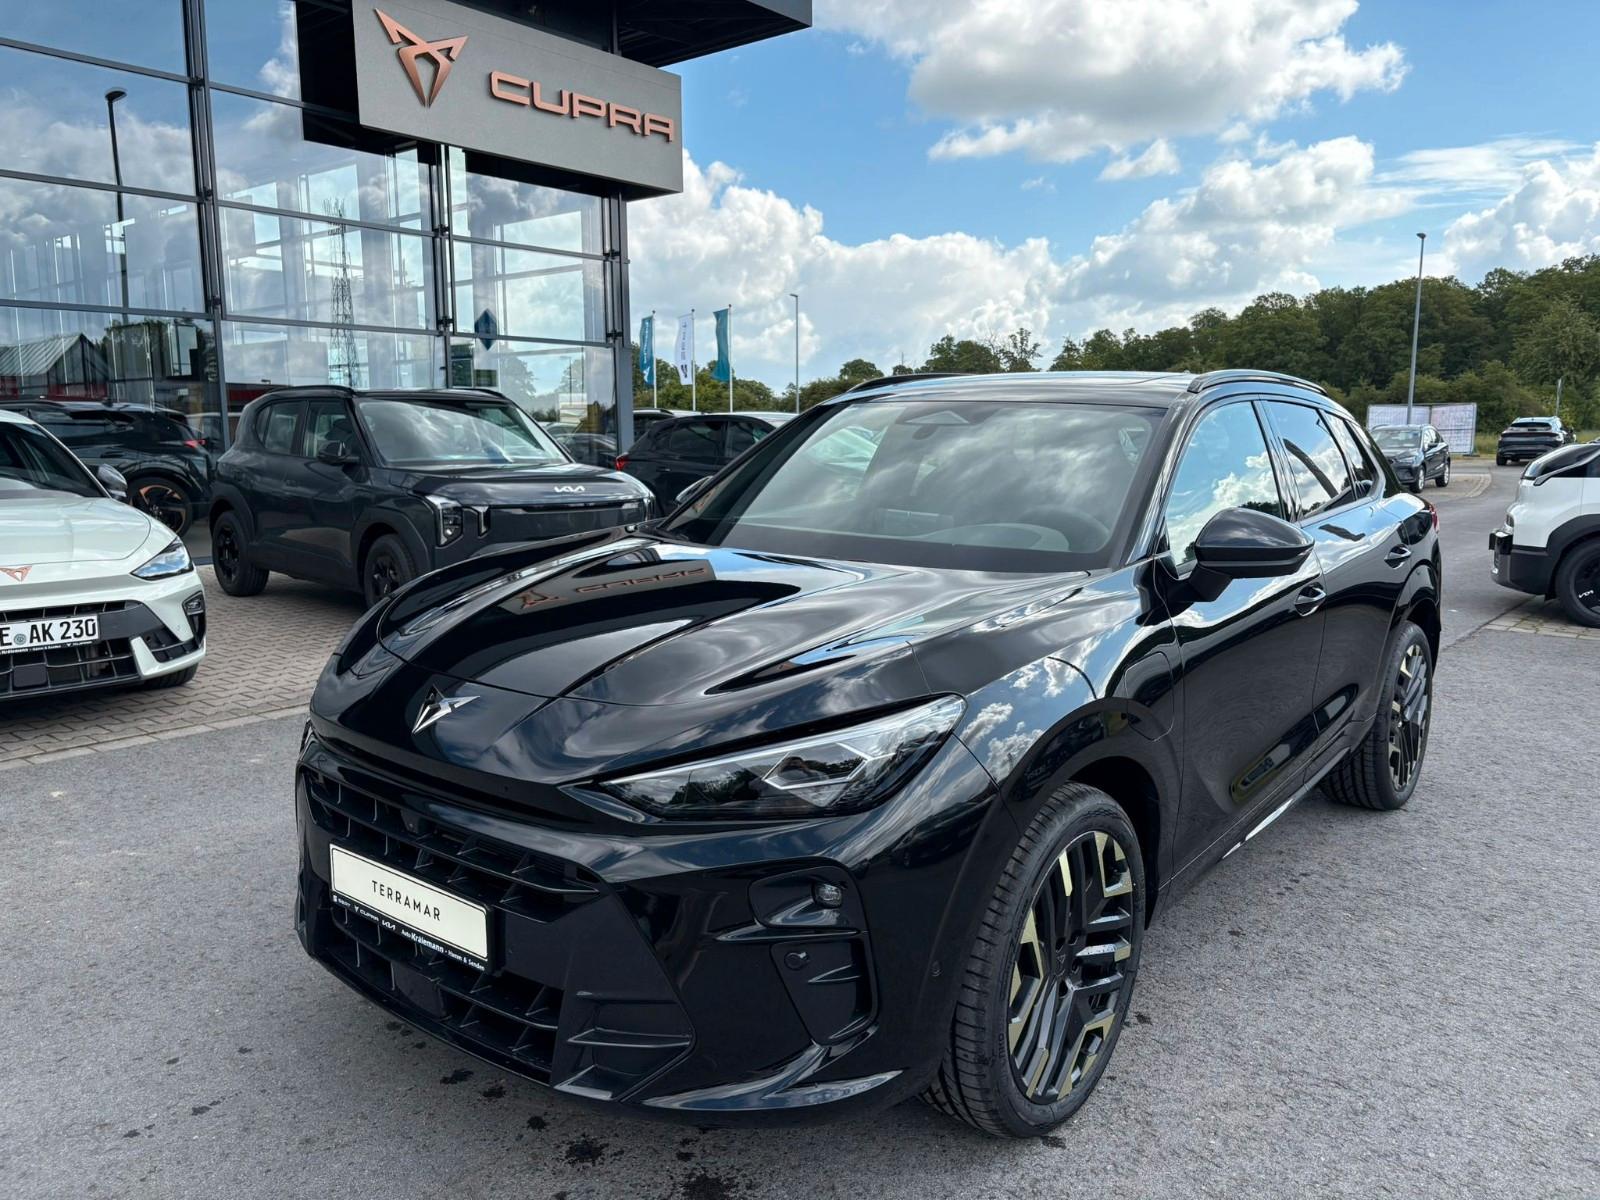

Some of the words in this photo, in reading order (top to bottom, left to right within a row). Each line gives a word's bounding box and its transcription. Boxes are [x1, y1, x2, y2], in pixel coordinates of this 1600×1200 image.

[490, 71, 674, 143] CUPRA
[554, 485, 586, 493] KIA
[29, 622, 54, 643] AK
[59, 618, 96, 640] 230
[372, 880, 440, 922] TERRAMAR
